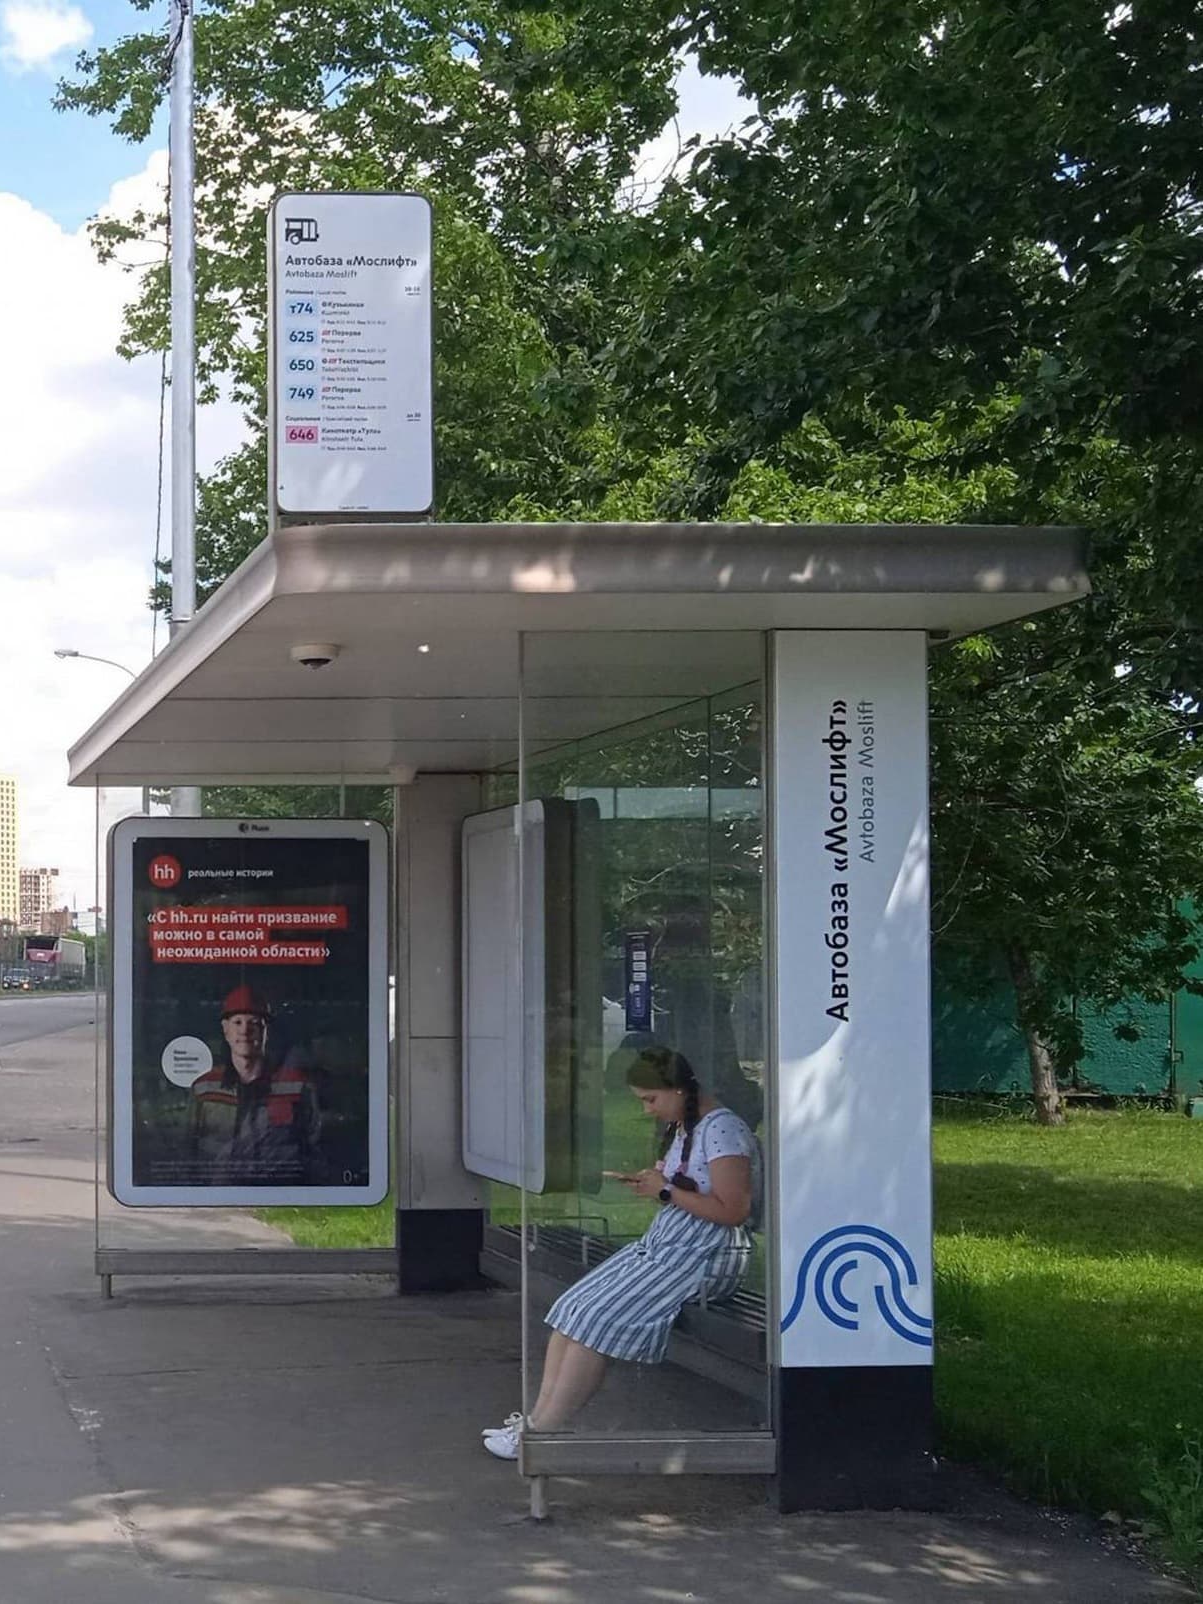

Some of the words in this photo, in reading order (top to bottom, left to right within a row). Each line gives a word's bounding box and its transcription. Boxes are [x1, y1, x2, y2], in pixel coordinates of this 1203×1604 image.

[285, 255, 343, 266] Автобаза
[346, 256, 417, 268] «Мослифт»
[285, 270, 324, 278] Avtobaza
[325, 270, 357, 278] Moslift
[289, 331, 314, 342] 625
[289, 359, 315, 371] 650
[289, 387, 315, 400] 749
[289, 429, 315, 441] 646
[856, 700, 875, 768] Moslift
[822, 700, 852, 872] «Мослифт»
[858, 776, 875, 863] Avtobaza
[154, 864, 175, 879] hh
[188, 869, 235, 878] реальные
[236, 869, 274, 878] истории
[170, 910, 208, 924] hh.ru
[212, 910, 254, 923] найти
[258, 911, 337, 927] призвание
[153, 930, 203, 941] можно
[206, 930, 214, 940] в
[219, 927, 264, 941] самой
[157, 944, 258, 959] неожиданной
[261, 944, 331, 958] области»
[824, 882, 849, 1022] Автобаза
